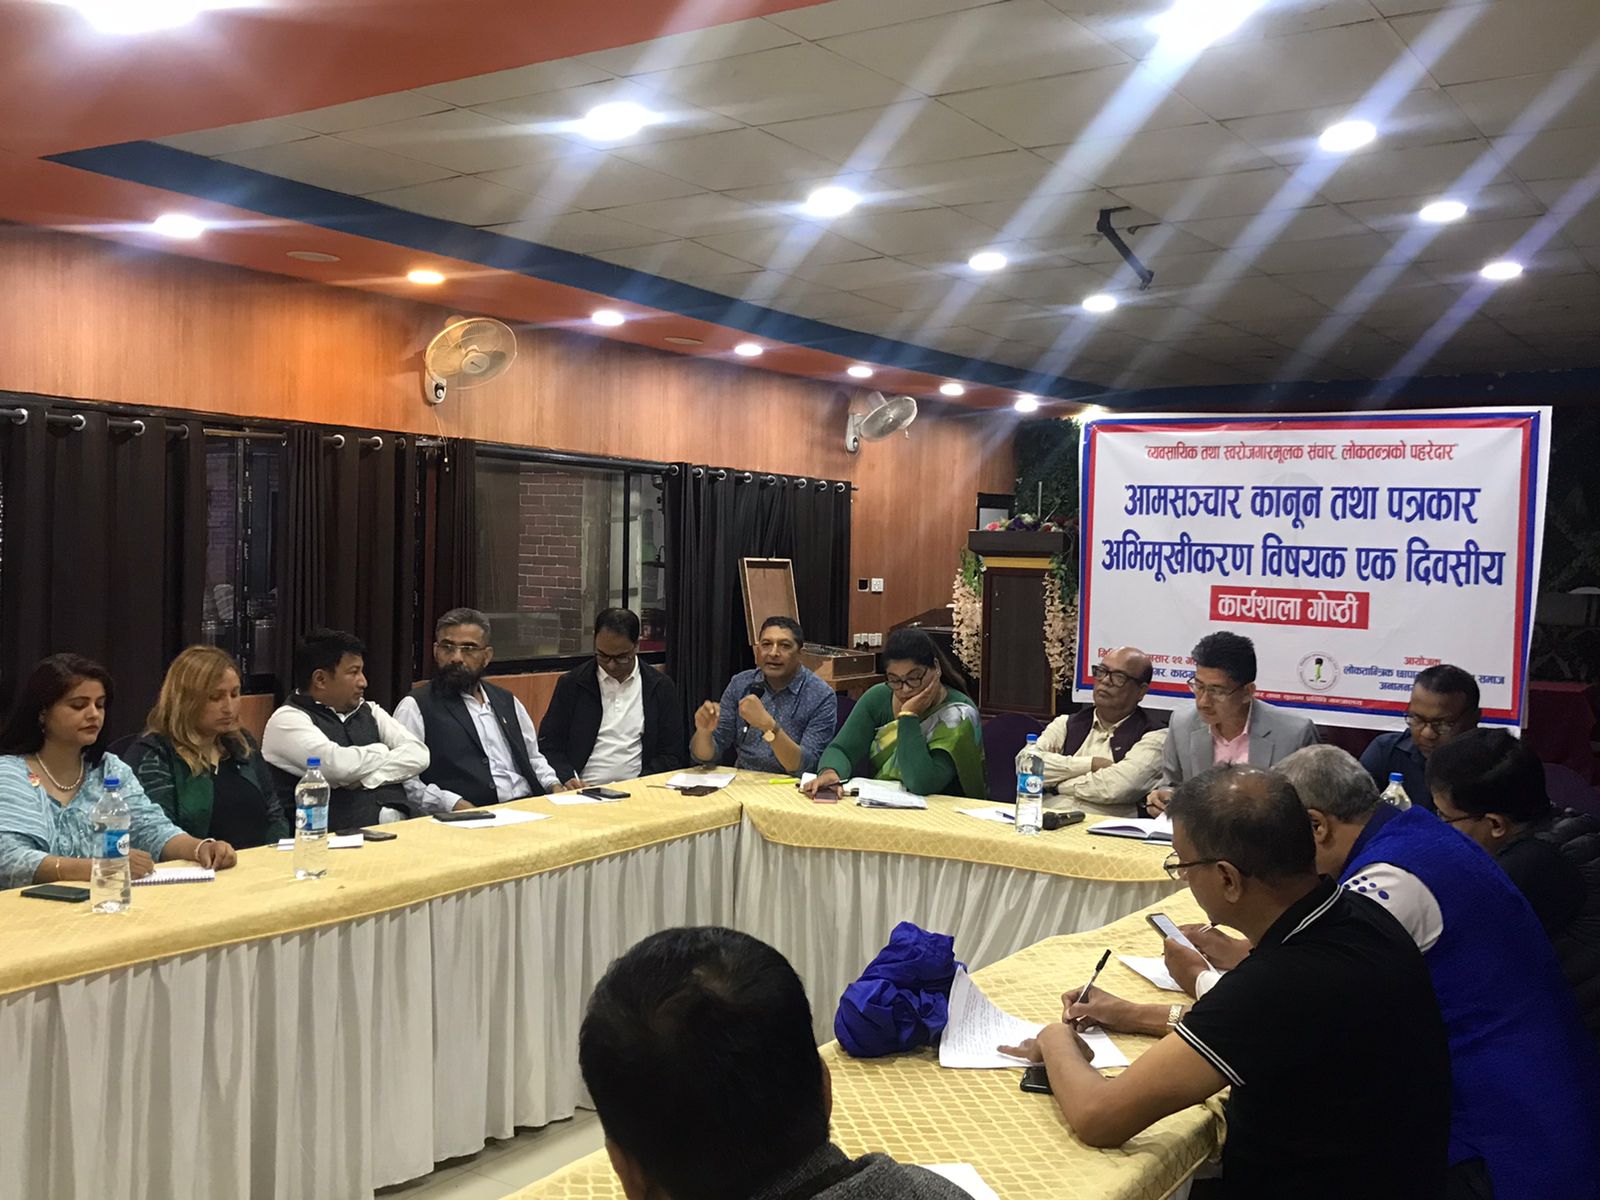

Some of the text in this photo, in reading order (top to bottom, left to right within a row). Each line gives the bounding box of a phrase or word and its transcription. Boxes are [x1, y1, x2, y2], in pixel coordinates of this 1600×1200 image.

[1201, 445, 1221, 460] तथा
[1223, 441, 1304, 464] स्वरोजगारमूलक
[1124, 484, 1482, 529] आमसञ्चार कानून तथा पत्रकार
[1101, 529, 1506, 587] अभिमूखीकरण विषयक एक दिवसीय
[1217, 590, 1360, 624] कार्यशाला गोष्ठी
[1478, 674, 1505, 685] समाज
